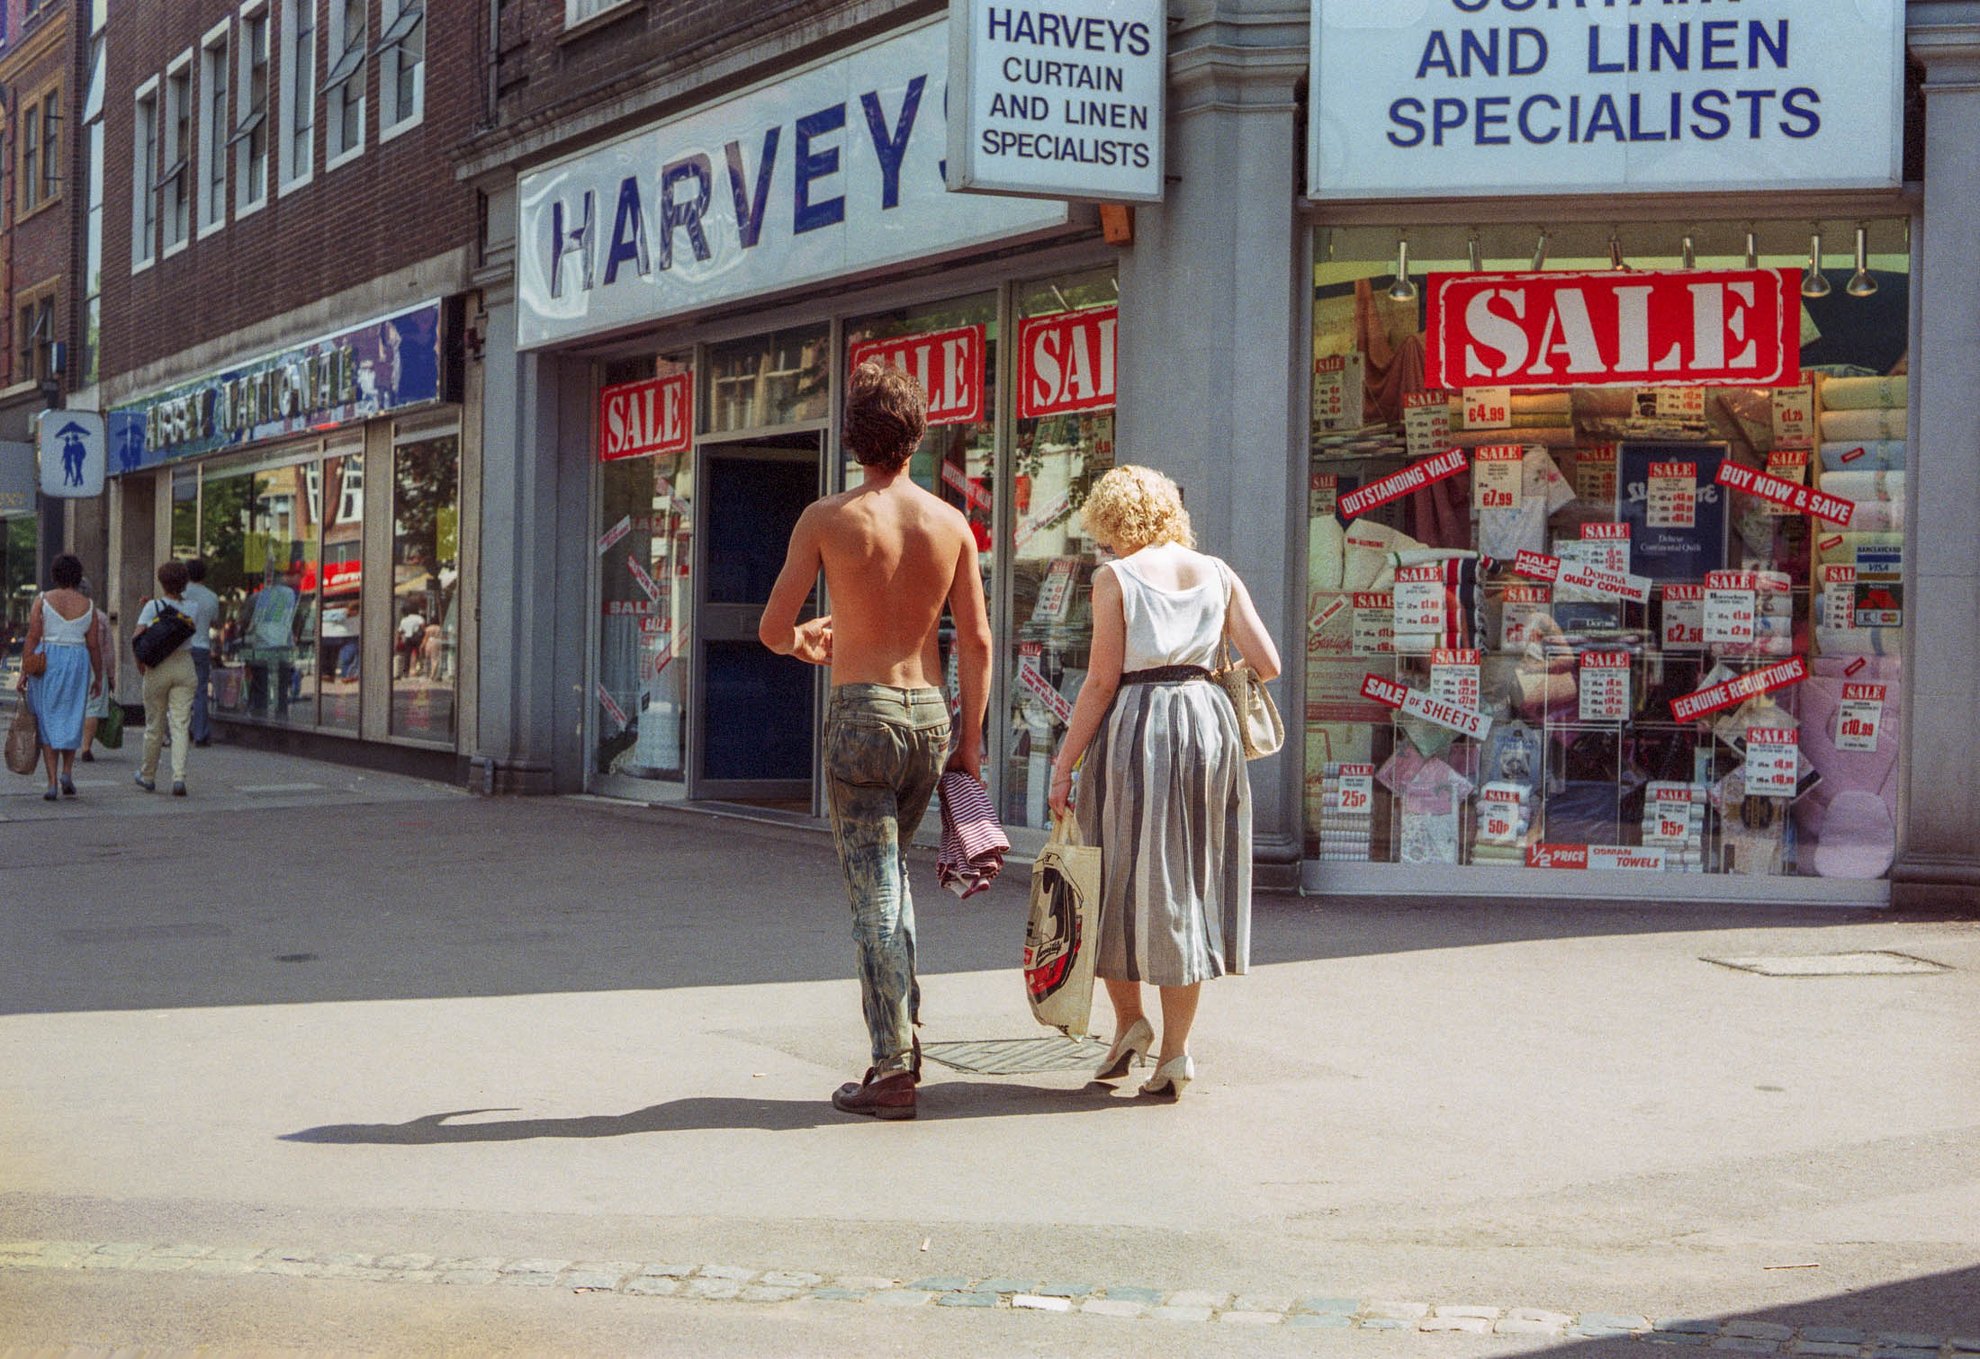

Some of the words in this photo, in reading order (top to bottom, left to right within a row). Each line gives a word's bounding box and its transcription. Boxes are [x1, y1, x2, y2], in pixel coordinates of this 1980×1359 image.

[988, 7, 1150, 56] HARVEYS
[1415, 27, 1548, 79] AND
[1587, 19, 1789, 73] LINEN
[1003, 57, 1123, 92] CURTAIN
[989, 93, 1049, 121] AND
[1065, 100, 1148, 130] LINEN
[1386, 87, 1822, 148] SPECIALISTS
[982, 129, 1149, 168] SPECIALISTS
[551, 74, 947, 299] HARVEY
[1465, 281, 1756, 378] SALE
[864, 337, 969, 412] LE
[1407, 391, 1445, 406] SALE
[608, 381, 680, 454] SALE
[1469, 403, 1505, 422] £4.99
[1480, 446, 1518, 459] SALE
[1653, 463, 1692, 476] SALE
[1313, 475, 1335, 488] SALE
[1341, 466, 1425, 513] OUTSTANDING
[1424, 449, 1466, 478] VALUE
[1482, 488, 1512, 506] £7.99
[1720, 464, 1752, 488] BUY
[1753, 476, 1793, 502] NOW
[1794, 489, 1807, 507] &
[1809, 495, 1850, 521] SAVE
[1585, 524, 1625, 538] SALE
[1519, 552, 1558, 567] HALF
[1868, 563, 1889, 571] VISA
[1400, 568, 1438, 582] SALE
[1515, 562, 1557, 578] PRICE
[1563, 574, 1594, 588] QUILT
[1597, 582, 1643, 599] COVERS
[1709, 575, 1750, 589] SALE
[1508, 587, 1546, 601] SALE
[1667, 586, 1703, 599] SALE
[1358, 594, 1394, 607] SALE
[1435, 650, 1475, 664] SALE
[1585, 652, 1627, 667] SALE
[1674, 685, 1729, 718] GENUINE
[1728, 660, 1803, 699] REDUCTIONS
[1846, 686, 1881, 700] SALE
[1365, 678, 1405, 704] SALE
[1408, 697, 1420, 707] OF
[1422, 699, 1480, 732] SHEETS
[1841, 719, 1874, 736] £10.99
[1751, 729, 1793, 743] SALE
[1343, 765, 1370, 775] SALE
[1661, 789, 1688, 800] SALE
[1553, 850, 1585, 863] PRICE
[1616, 857, 1659, 868] TOWELS
